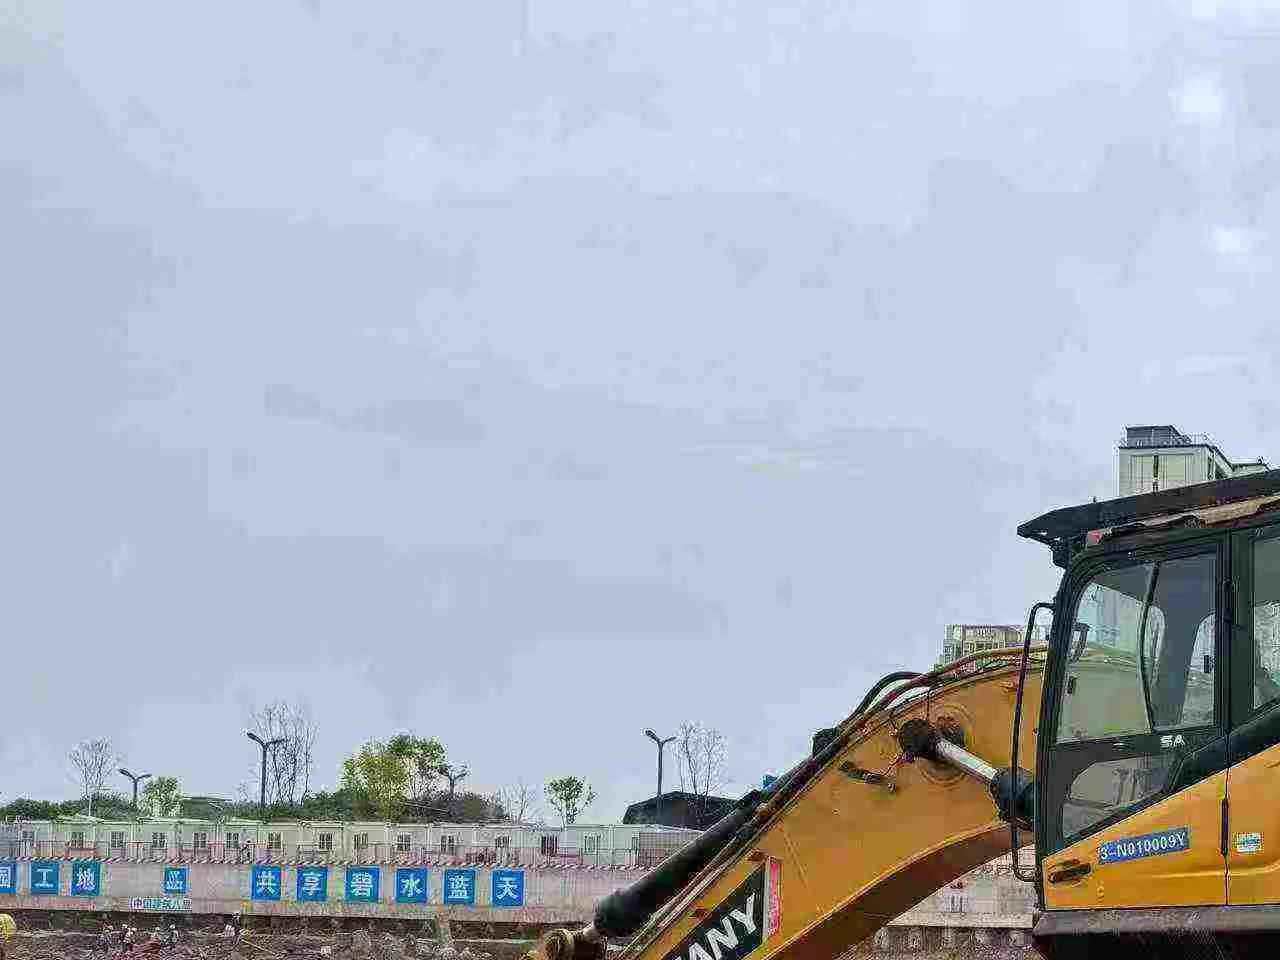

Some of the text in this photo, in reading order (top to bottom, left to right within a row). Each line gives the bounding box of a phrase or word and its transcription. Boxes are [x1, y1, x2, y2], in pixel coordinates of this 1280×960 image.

[256, 870, 518, 900] 共享碧水蓝天
